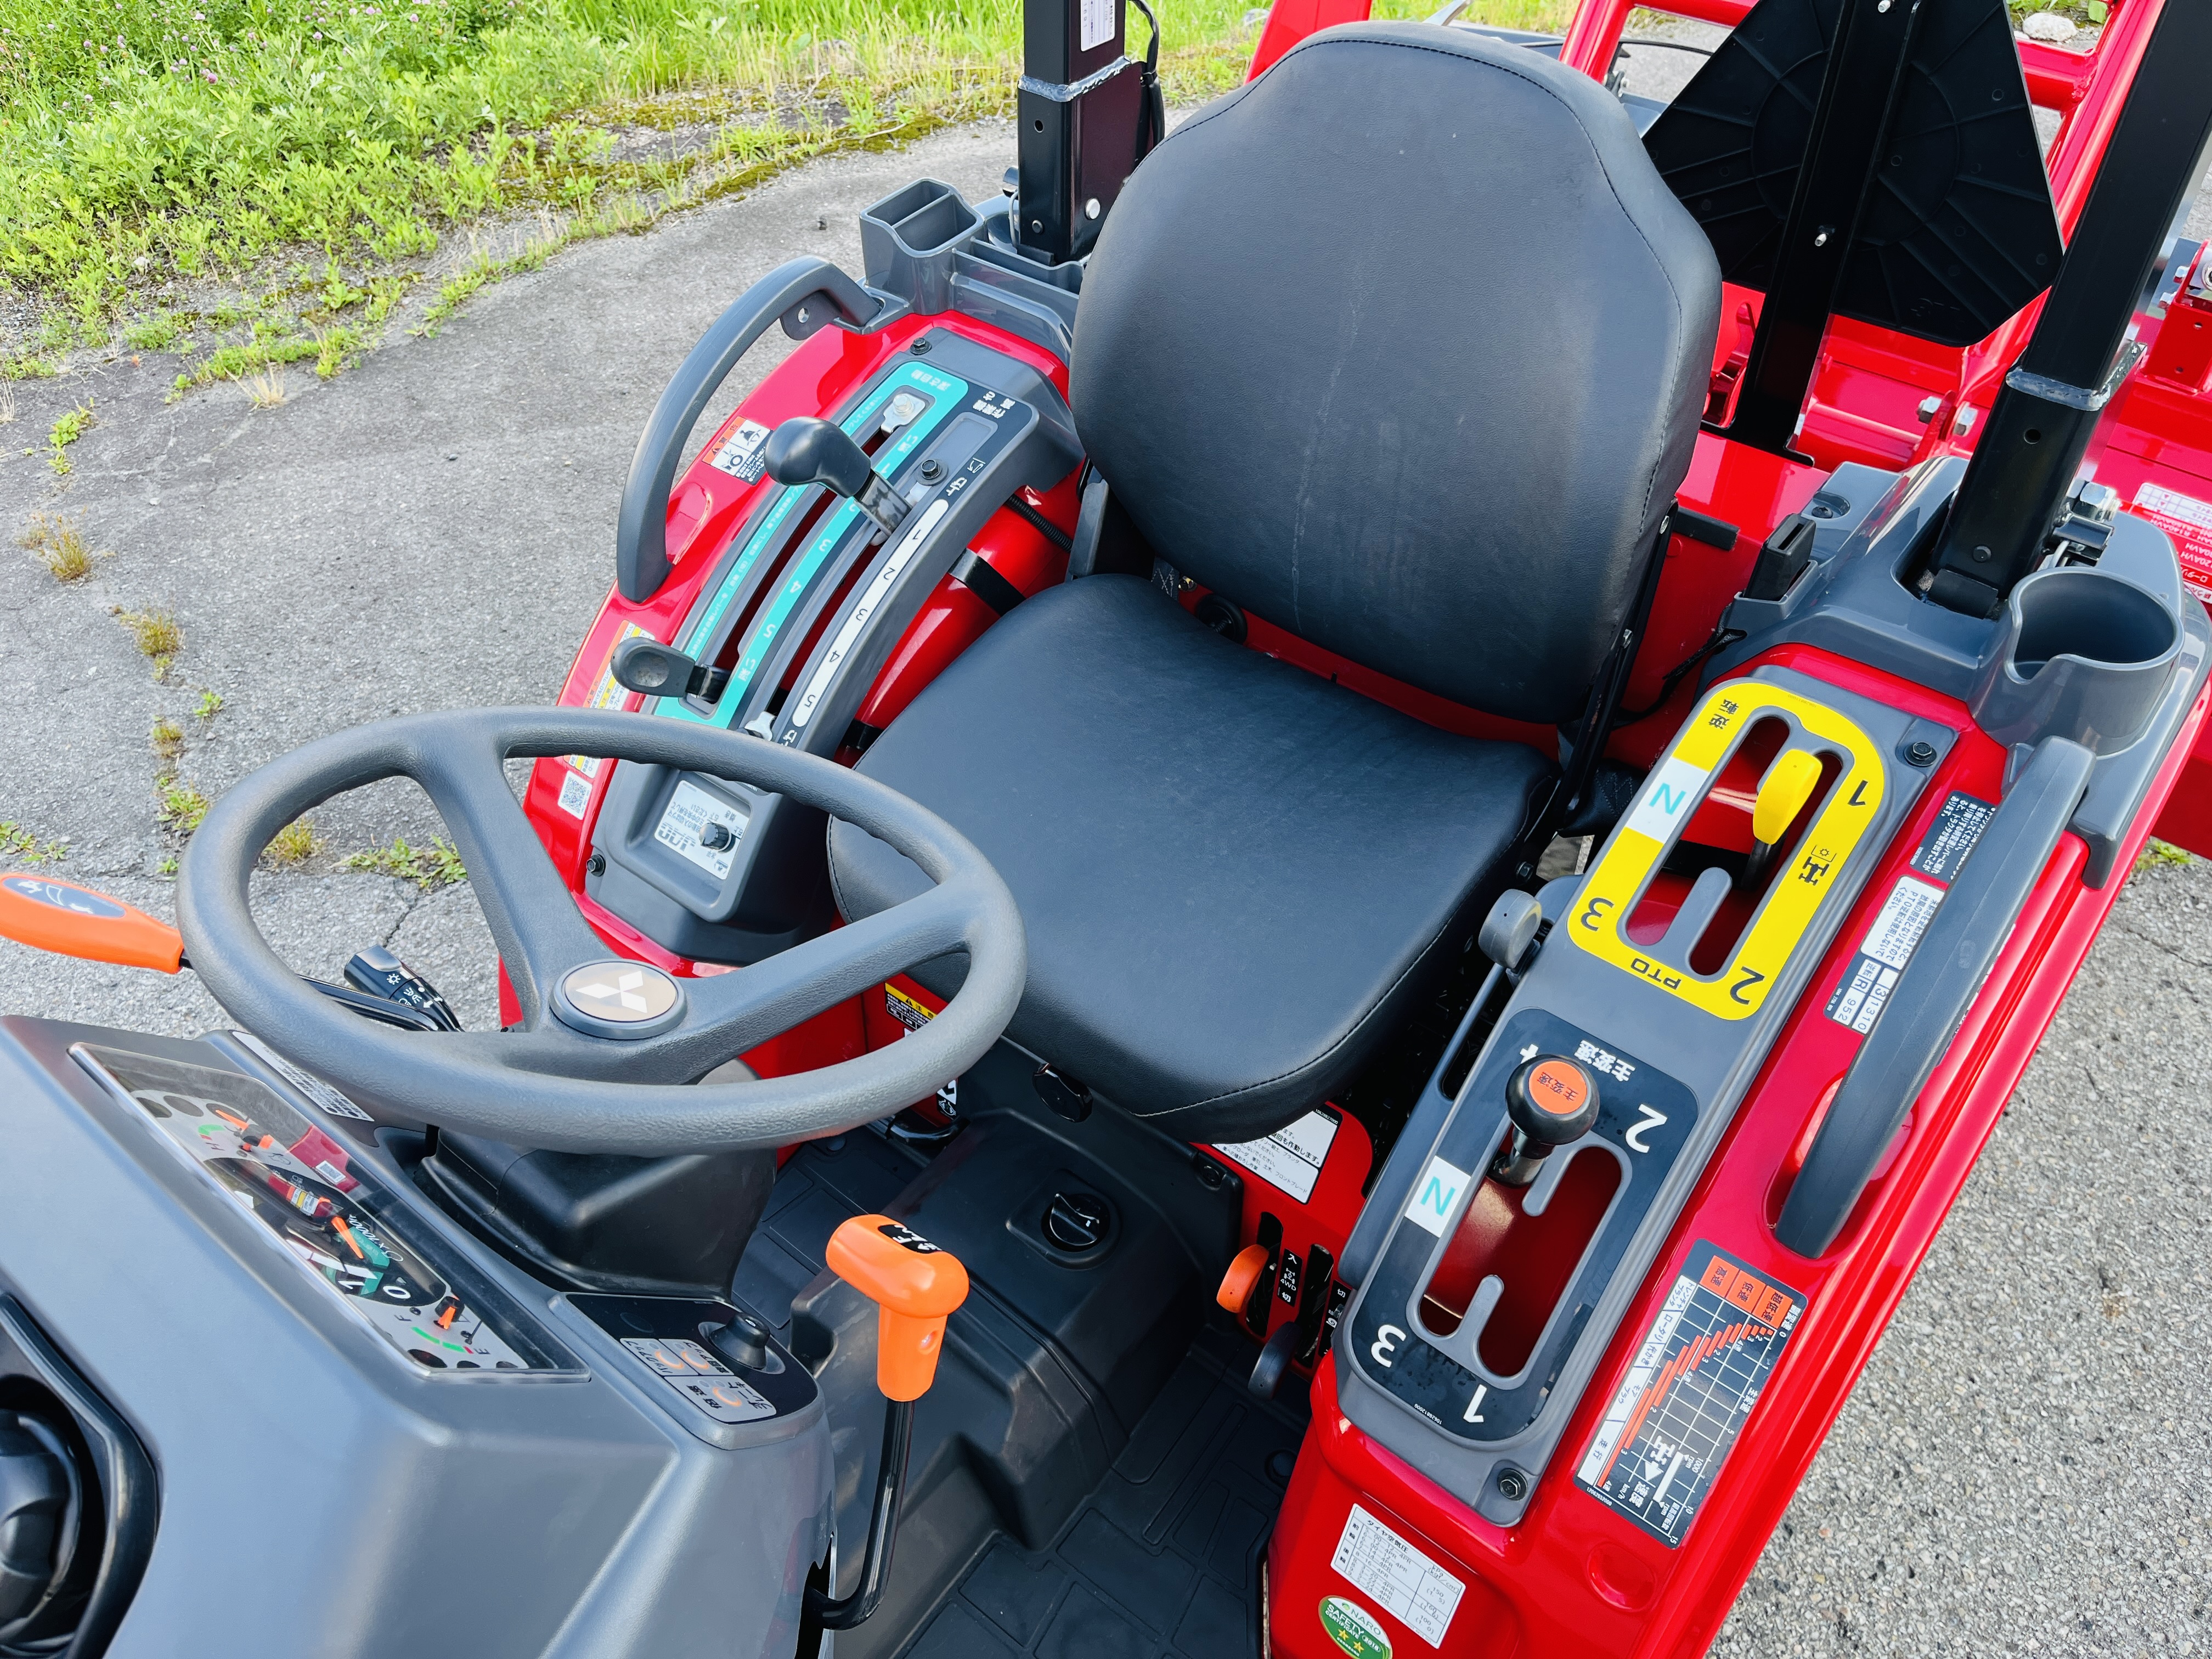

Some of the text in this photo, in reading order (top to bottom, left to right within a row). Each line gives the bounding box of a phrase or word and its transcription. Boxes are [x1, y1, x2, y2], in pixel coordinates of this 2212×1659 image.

[880, 461, 891, 475] 1
[944, 476, 967, 499] 上げ
[818, 538, 832, 552] 3
[912, 528, 923, 541] 1
[883, 567, 896, 580] 2
[788, 580, 802, 593] 4
[855, 607, 868, 621] 3
[763, 623, 777, 639] 5
[828, 650, 842, 663] 4
[803, 693, 817, 708] 5
[1648, 780, 1686, 817] N
[1846, 777, 1875, 811] 1
[1578, 892, 1615, 934] 3
[1628, 955, 1683, 991] PTO
[1861, 962, 1877, 979] 逆転
[1727, 964, 1766, 1008] 2
[1854, 977, 1869, 991] R
[1838, 997, 1855, 1022] 952
[1857, 986, 1887, 1031] 3 1310
[1573, 1038, 1637, 1086] 主変速
[1535, 1070, 1580, 1104] 主変速
[1621, 1101, 1670, 1156] 2
[1418, 1174, 1457, 1217] N
[1287, 1253, 1298, 1265] 入
[1279, 1278, 1296, 1291] 4WD
[1709, 1265, 1729, 1288] 高速
[382, 1285, 411, 1299] 0
[1280, 1291, 1291, 1302] 切
[1336, 1288, 1346, 1297] 切
[1735, 1279, 1756, 1303] 低速
[1760, 1291, 1785, 1323] 超低速
[1364, 1320, 1409, 1369] 3
[624, 1340, 673, 1374] バックアップ
[1460, 1382, 1498, 1428] 1
[1627, 1480, 1651, 1508] 速度
[1366, 1519, 1409, 1554] タイヤ空気圧
[1431, 1587, 1444, 1598] 150
[1324, 1610, 1359, 1639] CERTIFICATE
[1326, 1604, 1365, 1635] SAFETY
[1350, 1609, 1382, 1636] NARO
[1418, 1615, 1432, 1626] 100
